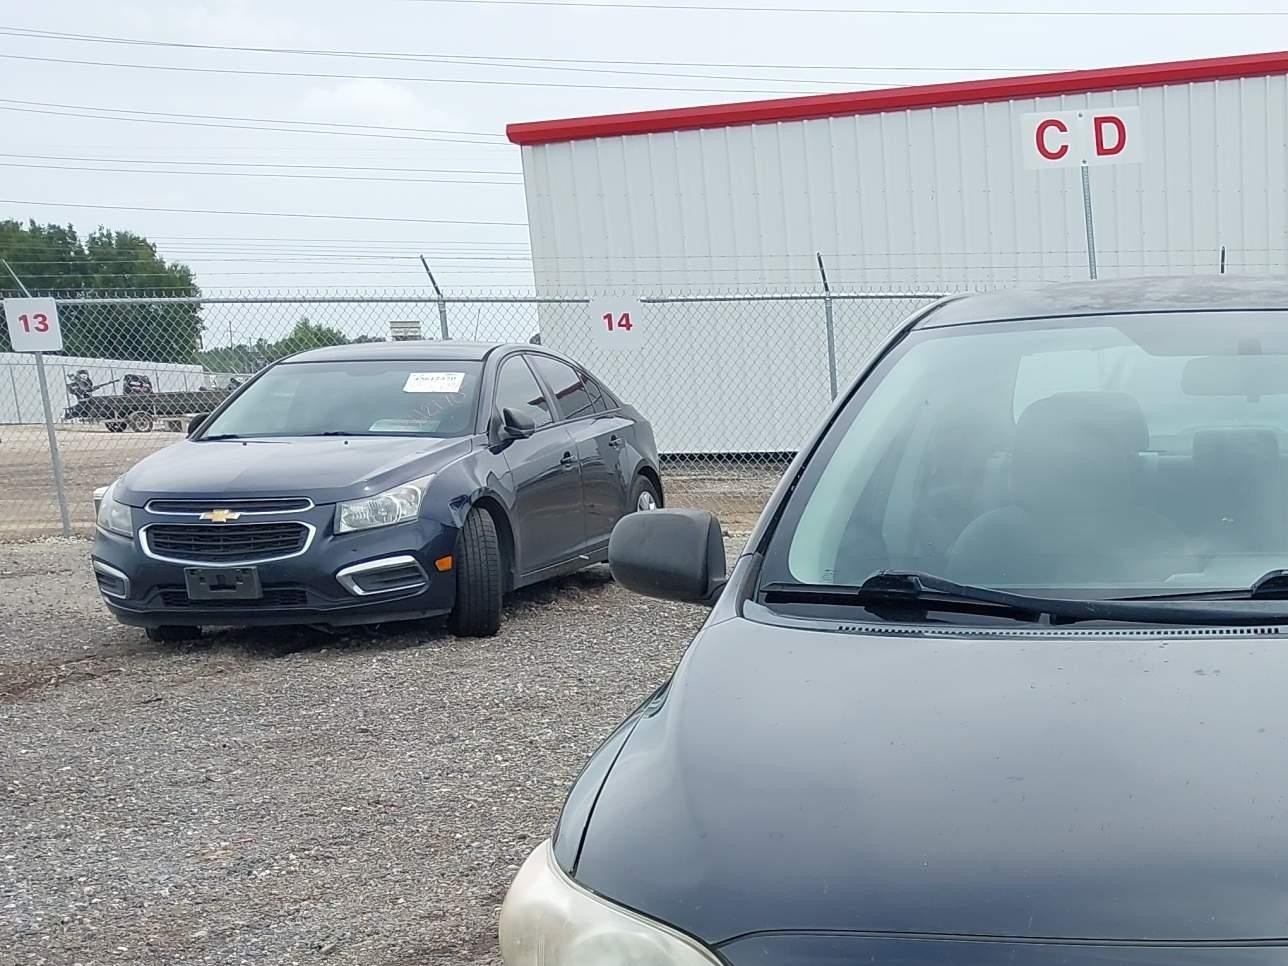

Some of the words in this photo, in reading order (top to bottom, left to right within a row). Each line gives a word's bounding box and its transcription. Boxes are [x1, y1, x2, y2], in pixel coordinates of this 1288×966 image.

[1035, 118, 1069, 160] C
[1093, 115, 1127, 156] D
[18, 313, 49, 333] 13
[602, 312, 633, 331] 14
